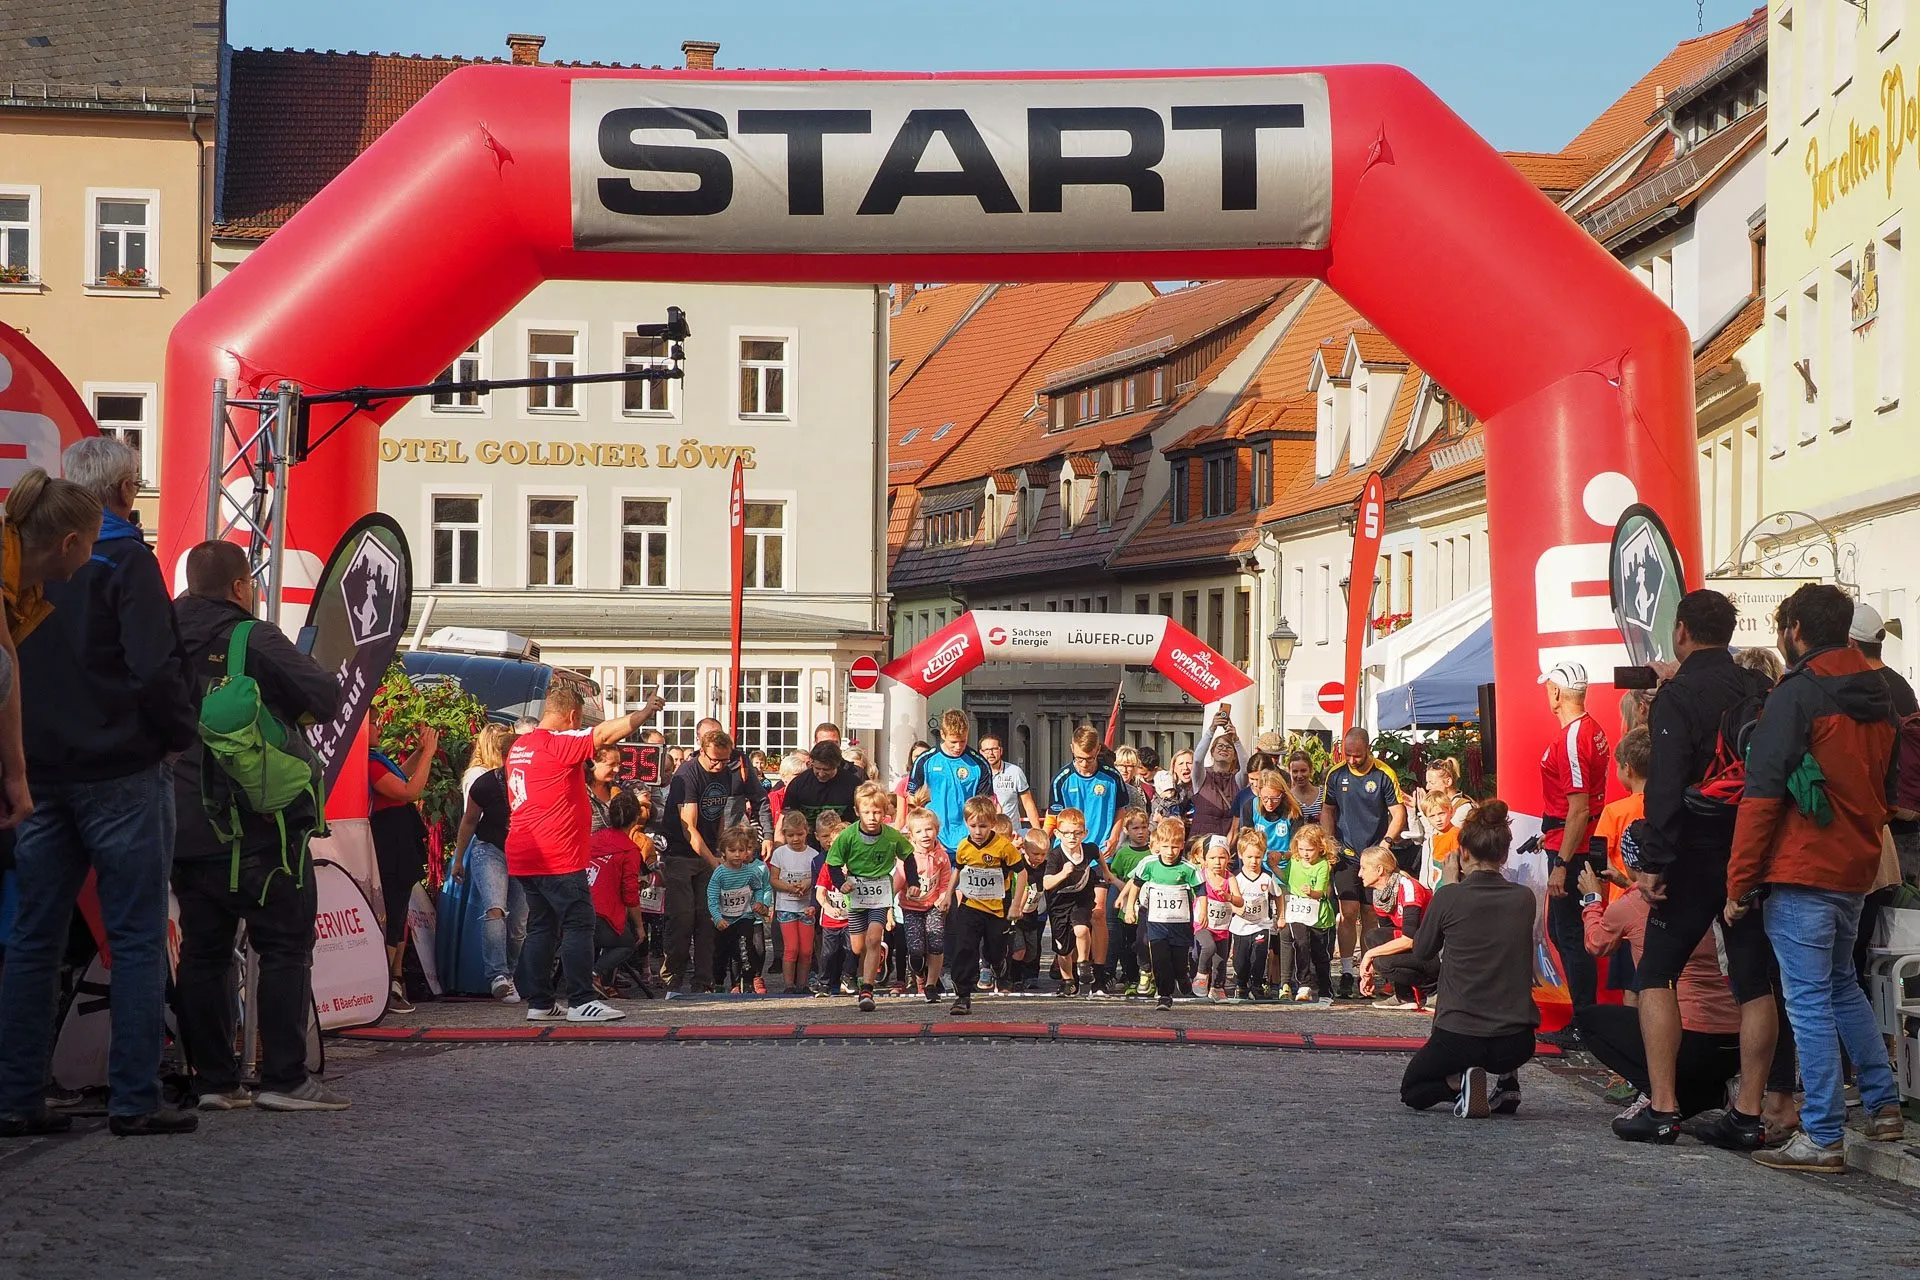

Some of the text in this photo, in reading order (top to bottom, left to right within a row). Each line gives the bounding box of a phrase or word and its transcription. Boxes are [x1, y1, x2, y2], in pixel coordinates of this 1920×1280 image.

[1881, 63, 1920, 200] Po
[597, 104, 1305, 216] START
[379, 438, 757, 470] OTEL GOLDNER LÖWE
[1012, 628, 1052, 637] Sachsen
[1068, 629, 1155, 646] LÄUFER-CUP
[1012, 637, 1049, 648] Energie
[930, 646, 961, 671] ZVON
[1171, 648, 1221, 691] OPPACHER
[702, 796, 728, 807] ESPRIT
[967, 875, 996, 888] 1104
[856, 885, 883, 896] 1336
[723, 896, 746, 907] 1523
[1156, 899, 1183, 910] 1187
[1244, 904, 1262, 915] 383
[1290, 904, 1312, 914] 1329
[340, 992, 374, 1010] BaerService
